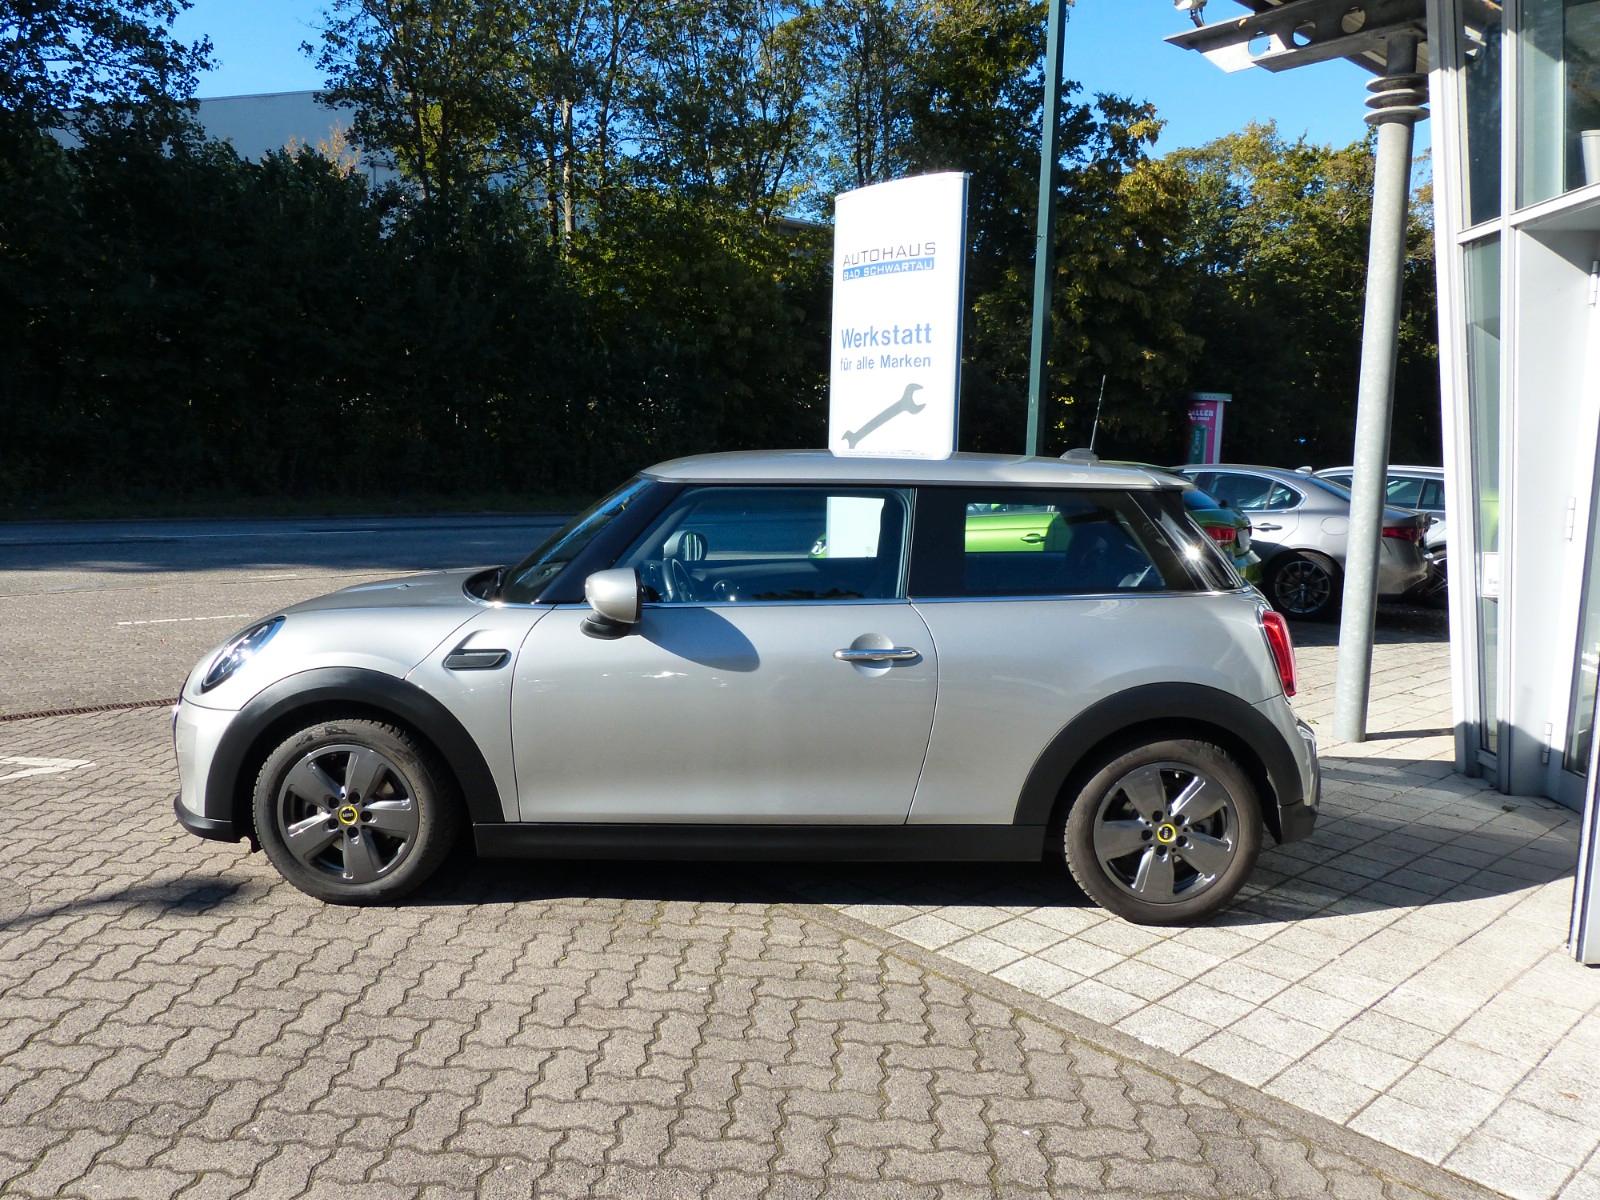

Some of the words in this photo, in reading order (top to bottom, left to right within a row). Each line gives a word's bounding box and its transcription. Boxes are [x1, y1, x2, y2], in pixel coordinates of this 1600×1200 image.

[842, 241, 936, 267] AUTOHAUS
[843, 269, 860, 280] BAD
[863, 260, 933, 277] SCHWARTAU
[841, 323, 932, 349] Werkstatt
[840, 357, 852, 371] für
[856, 356, 875, 370] alle
[880, 354, 931, 369] Marken
